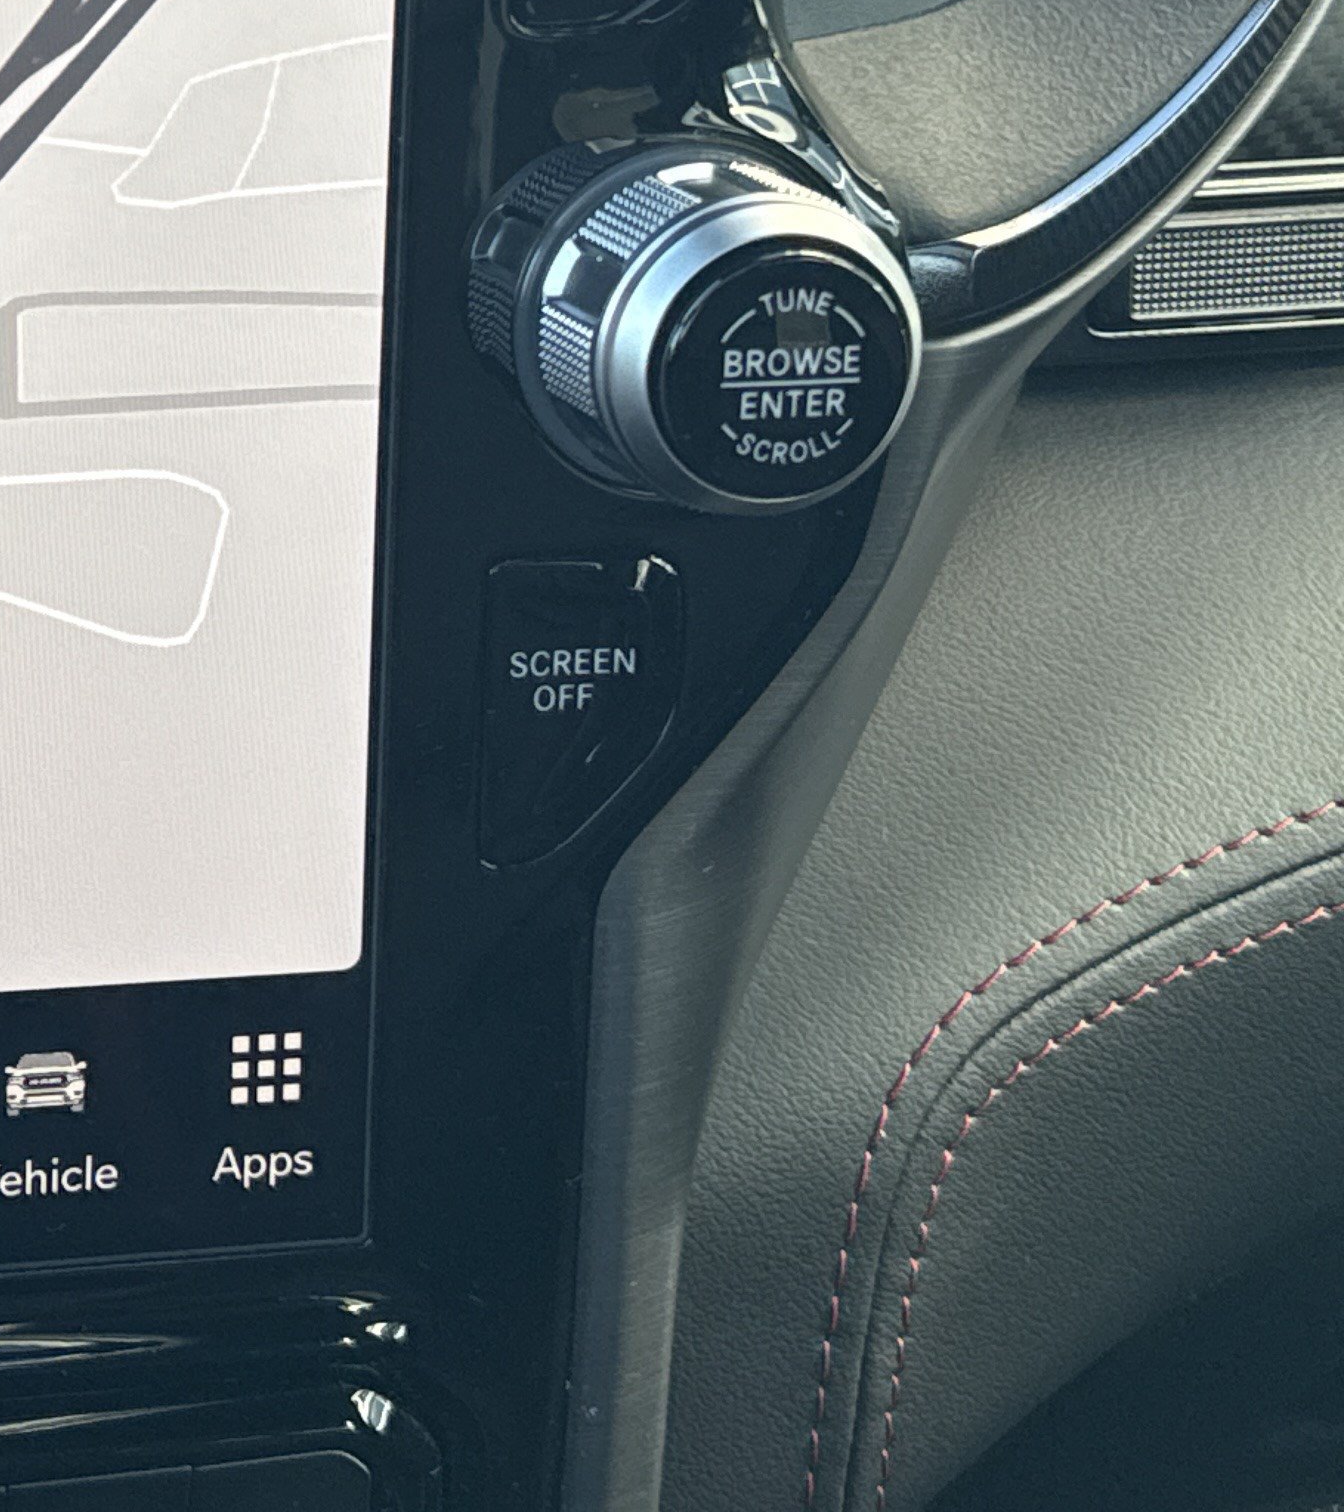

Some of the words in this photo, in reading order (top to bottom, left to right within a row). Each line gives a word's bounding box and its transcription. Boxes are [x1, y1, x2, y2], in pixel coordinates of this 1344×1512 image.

[758, 288, 836, 317] TUNE
[722, 344, 862, 379] BROWSE
[738, 389, 845, 421] ENTER
[736, 430, 842, 465] SCROLL
[509, 648, 636, 679] SCREEN
[533, 683, 594, 712] OFF
[212, 1146, 314, 1189] Apps
